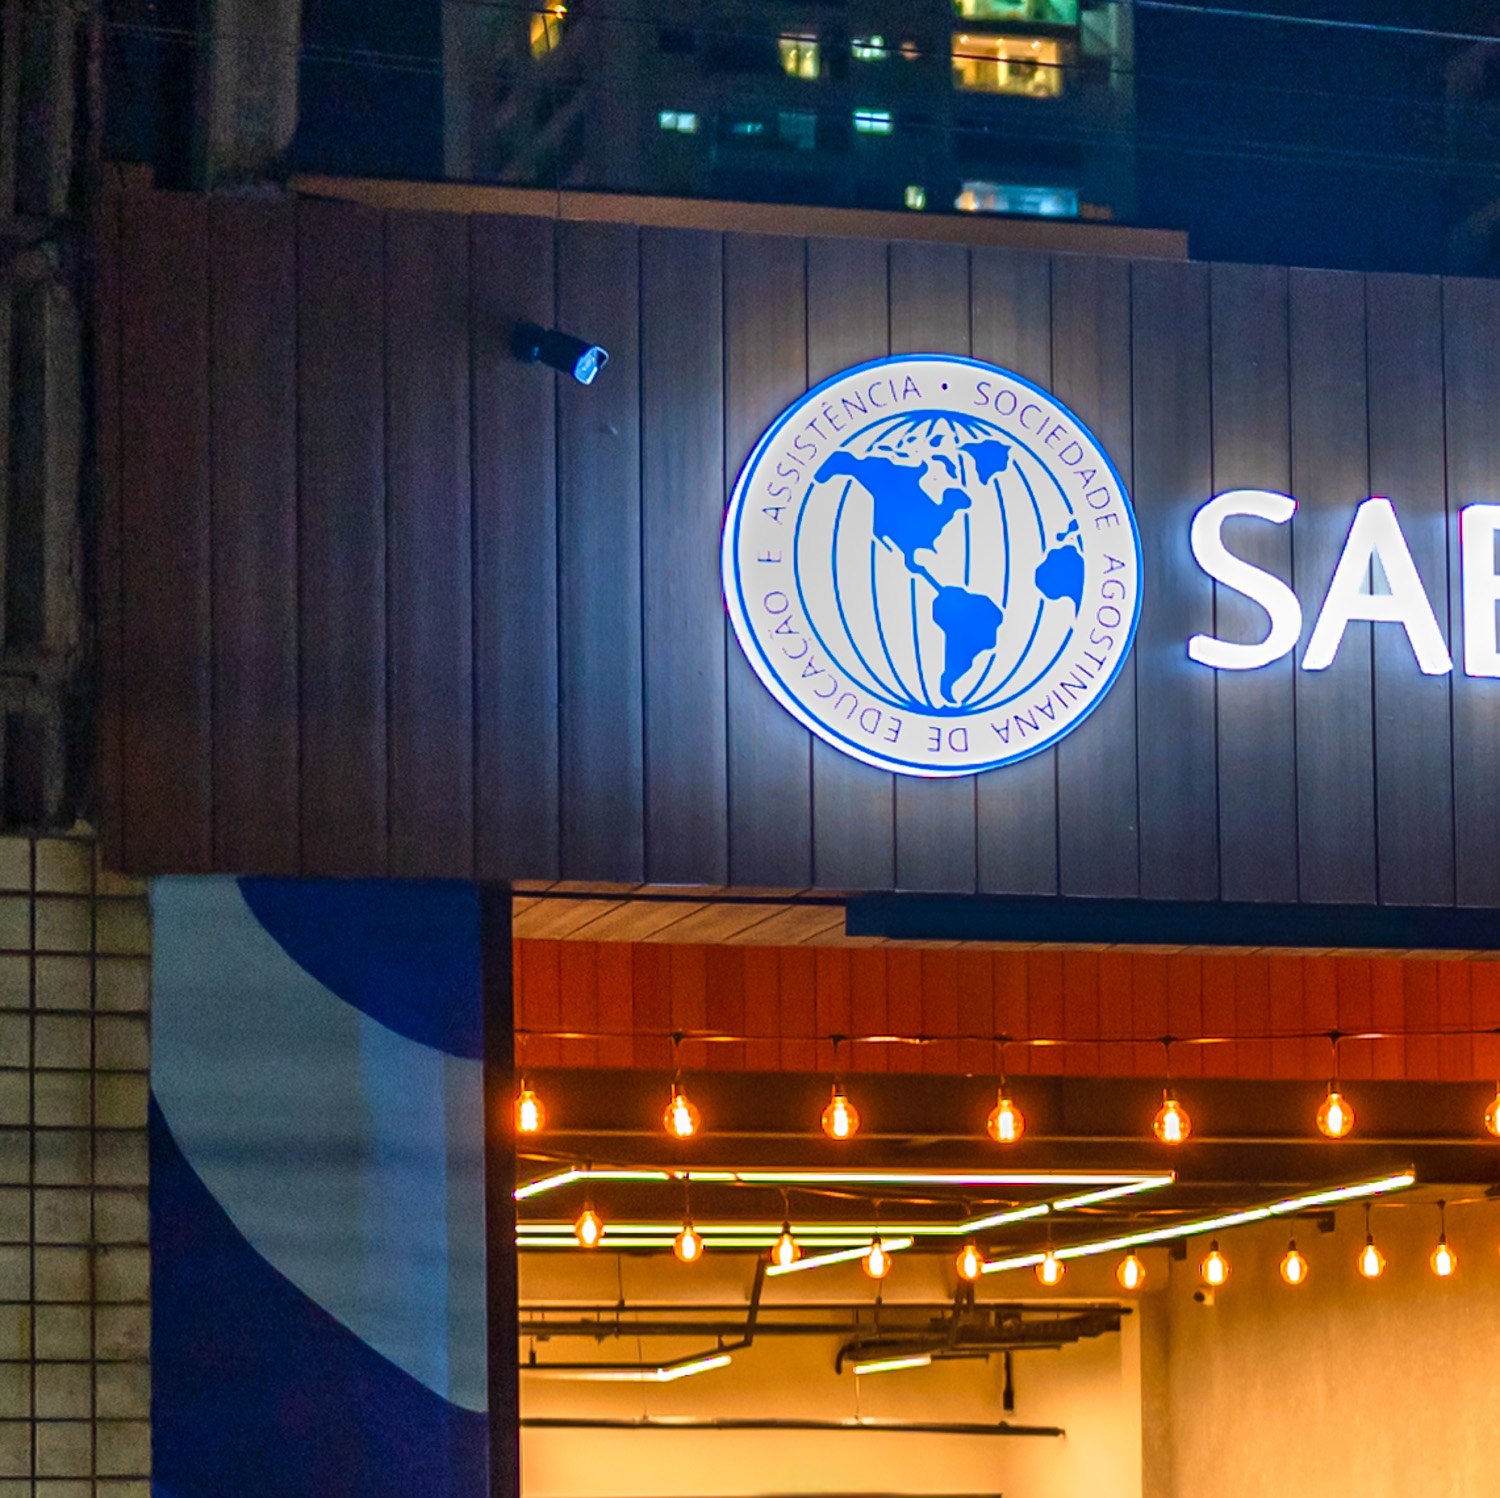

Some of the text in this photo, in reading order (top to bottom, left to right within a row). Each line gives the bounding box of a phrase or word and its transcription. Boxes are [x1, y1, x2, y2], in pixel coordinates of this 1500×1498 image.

[757, 375, 1127, 753] SOCIEDADE AGOSTINIANA DE EDUCAÇÃO E ASSISTÊNCIA
